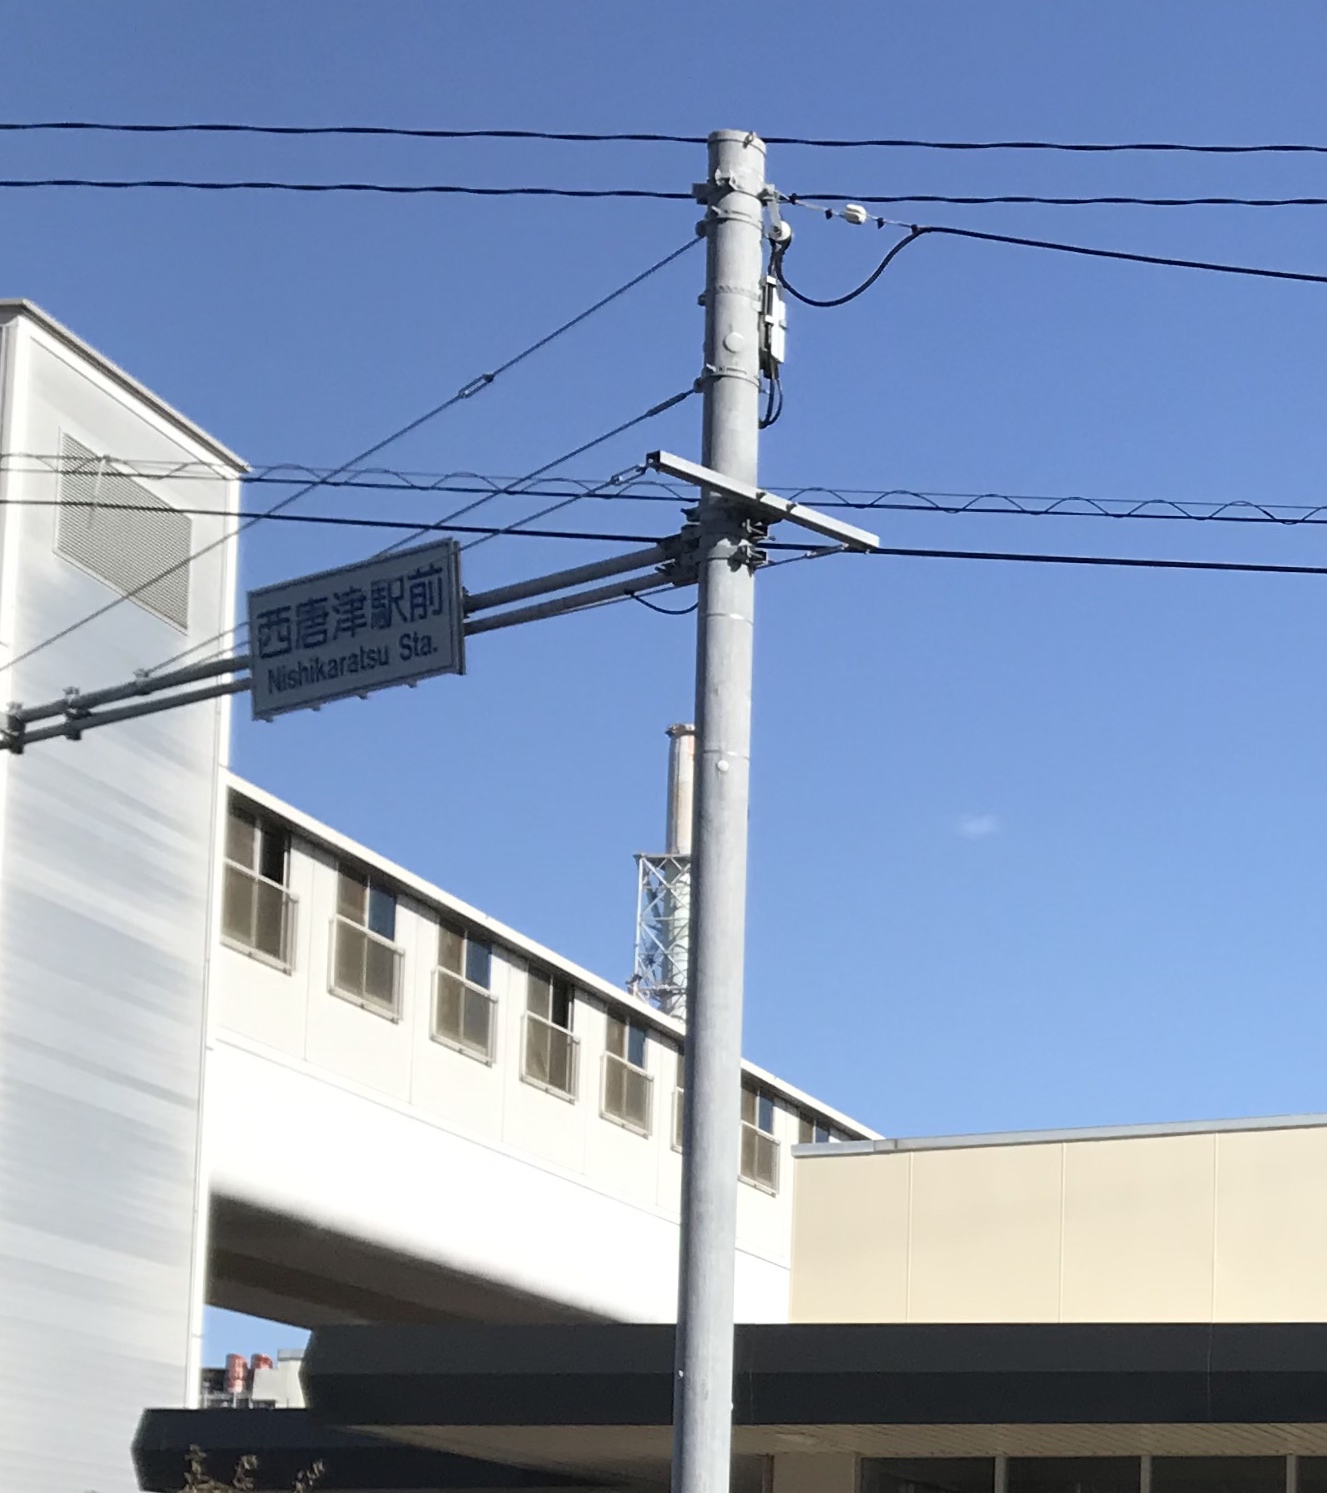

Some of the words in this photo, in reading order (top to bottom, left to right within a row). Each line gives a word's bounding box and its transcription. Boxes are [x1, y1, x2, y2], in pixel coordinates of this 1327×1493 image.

[256, 562, 444, 660] 西唐津駅前
[267, 645, 390, 695] Nishikaratsu
[398, 631, 438, 662] Sta.
